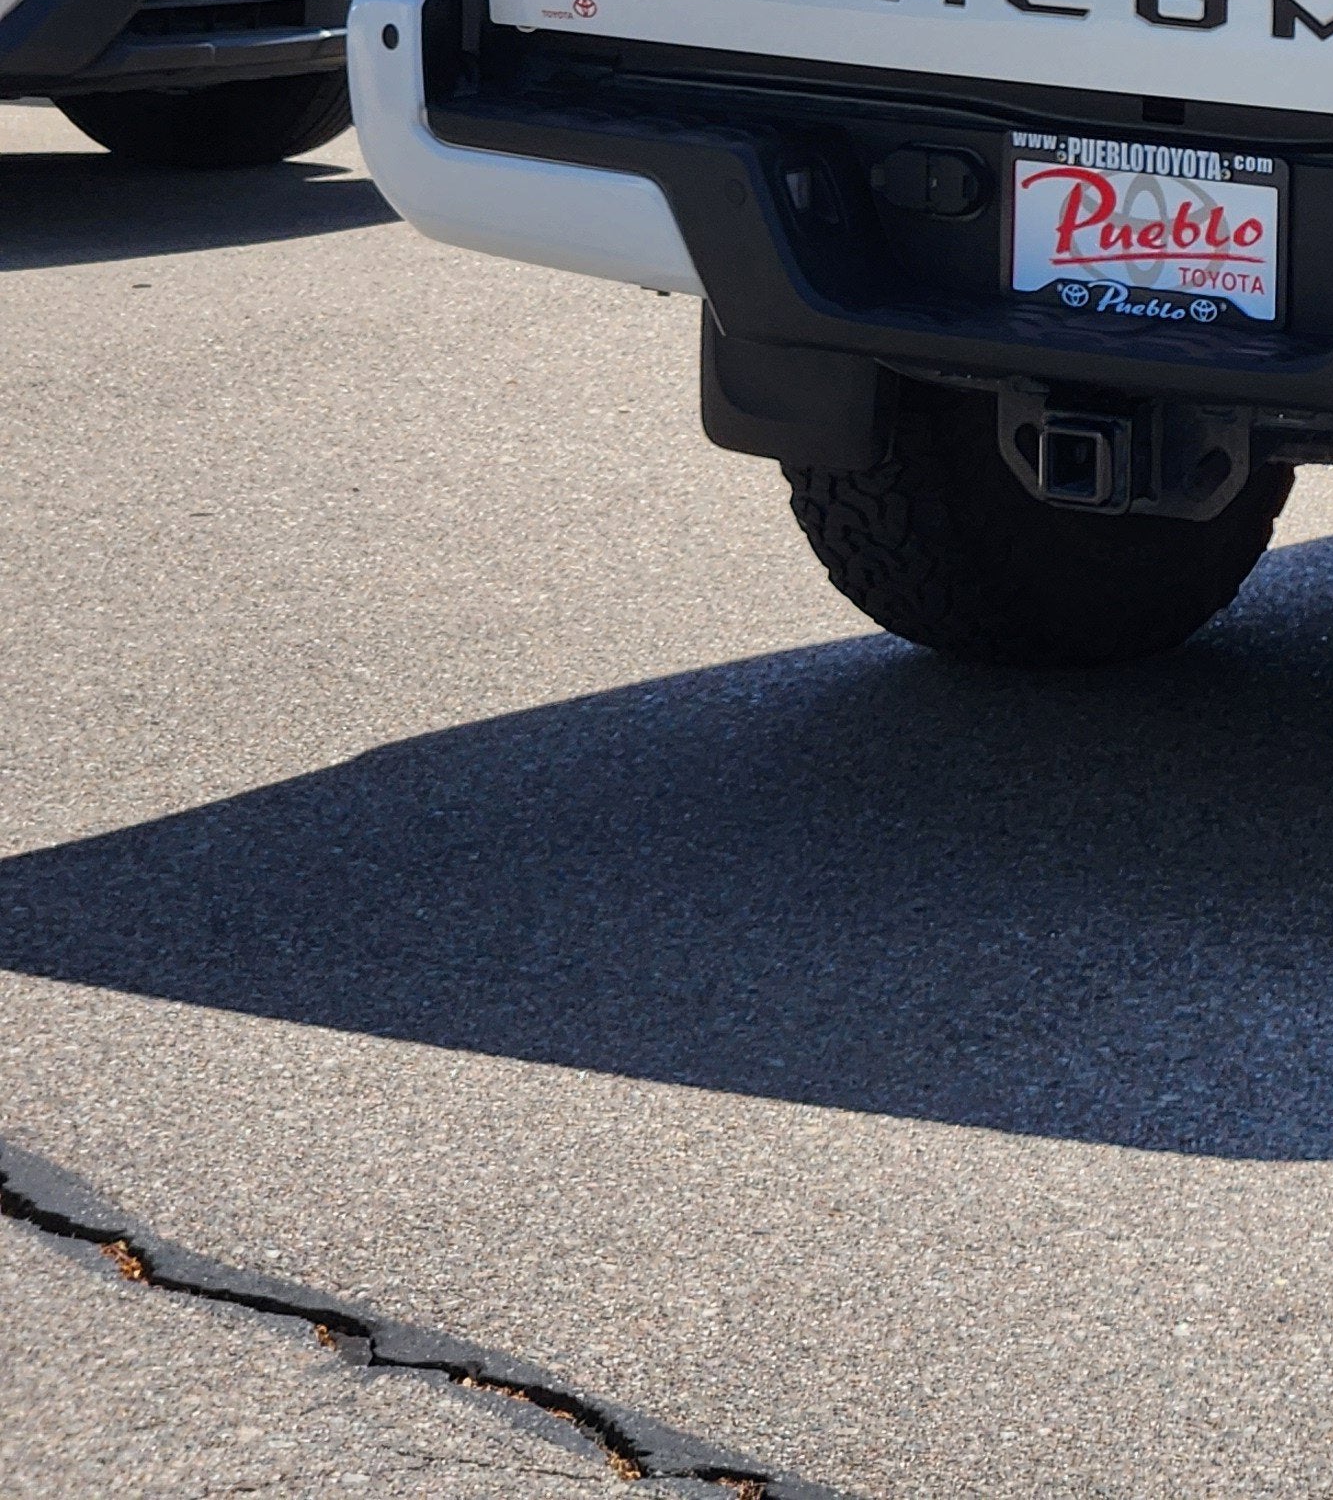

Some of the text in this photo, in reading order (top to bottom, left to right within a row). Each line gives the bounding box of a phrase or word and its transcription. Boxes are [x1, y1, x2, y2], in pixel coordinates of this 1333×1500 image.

[1022, 167, 1264, 254] Pueblo
[1088, 280, 1187, 320] Pueblo
[1179, 267, 1265, 295] TOYOTA
